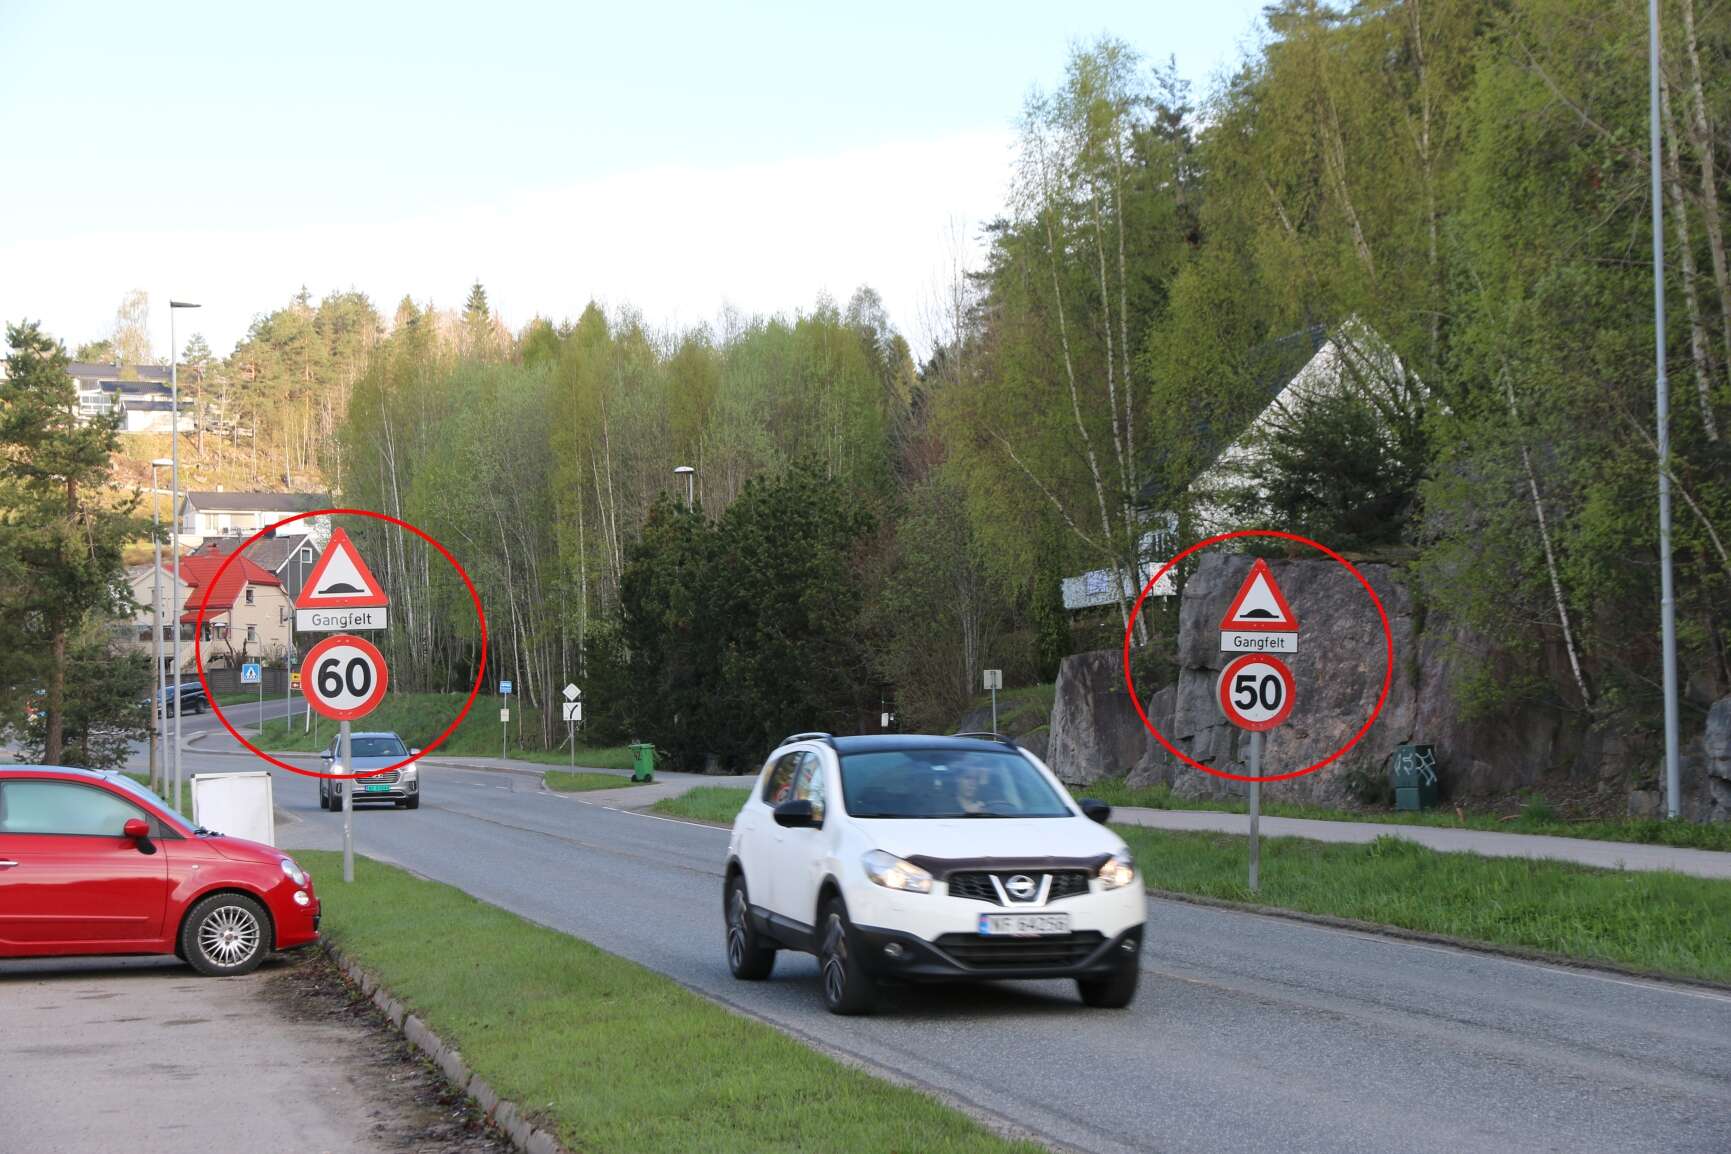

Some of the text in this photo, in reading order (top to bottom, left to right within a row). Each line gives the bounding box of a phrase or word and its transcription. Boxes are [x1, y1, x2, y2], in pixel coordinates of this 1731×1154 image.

[312, 613, 372, 628] Gangfelt
[1234, 636, 1285, 650] Gangfelt
[317, 657, 371, 698] 60
[1234, 674, 1282, 711] 50
